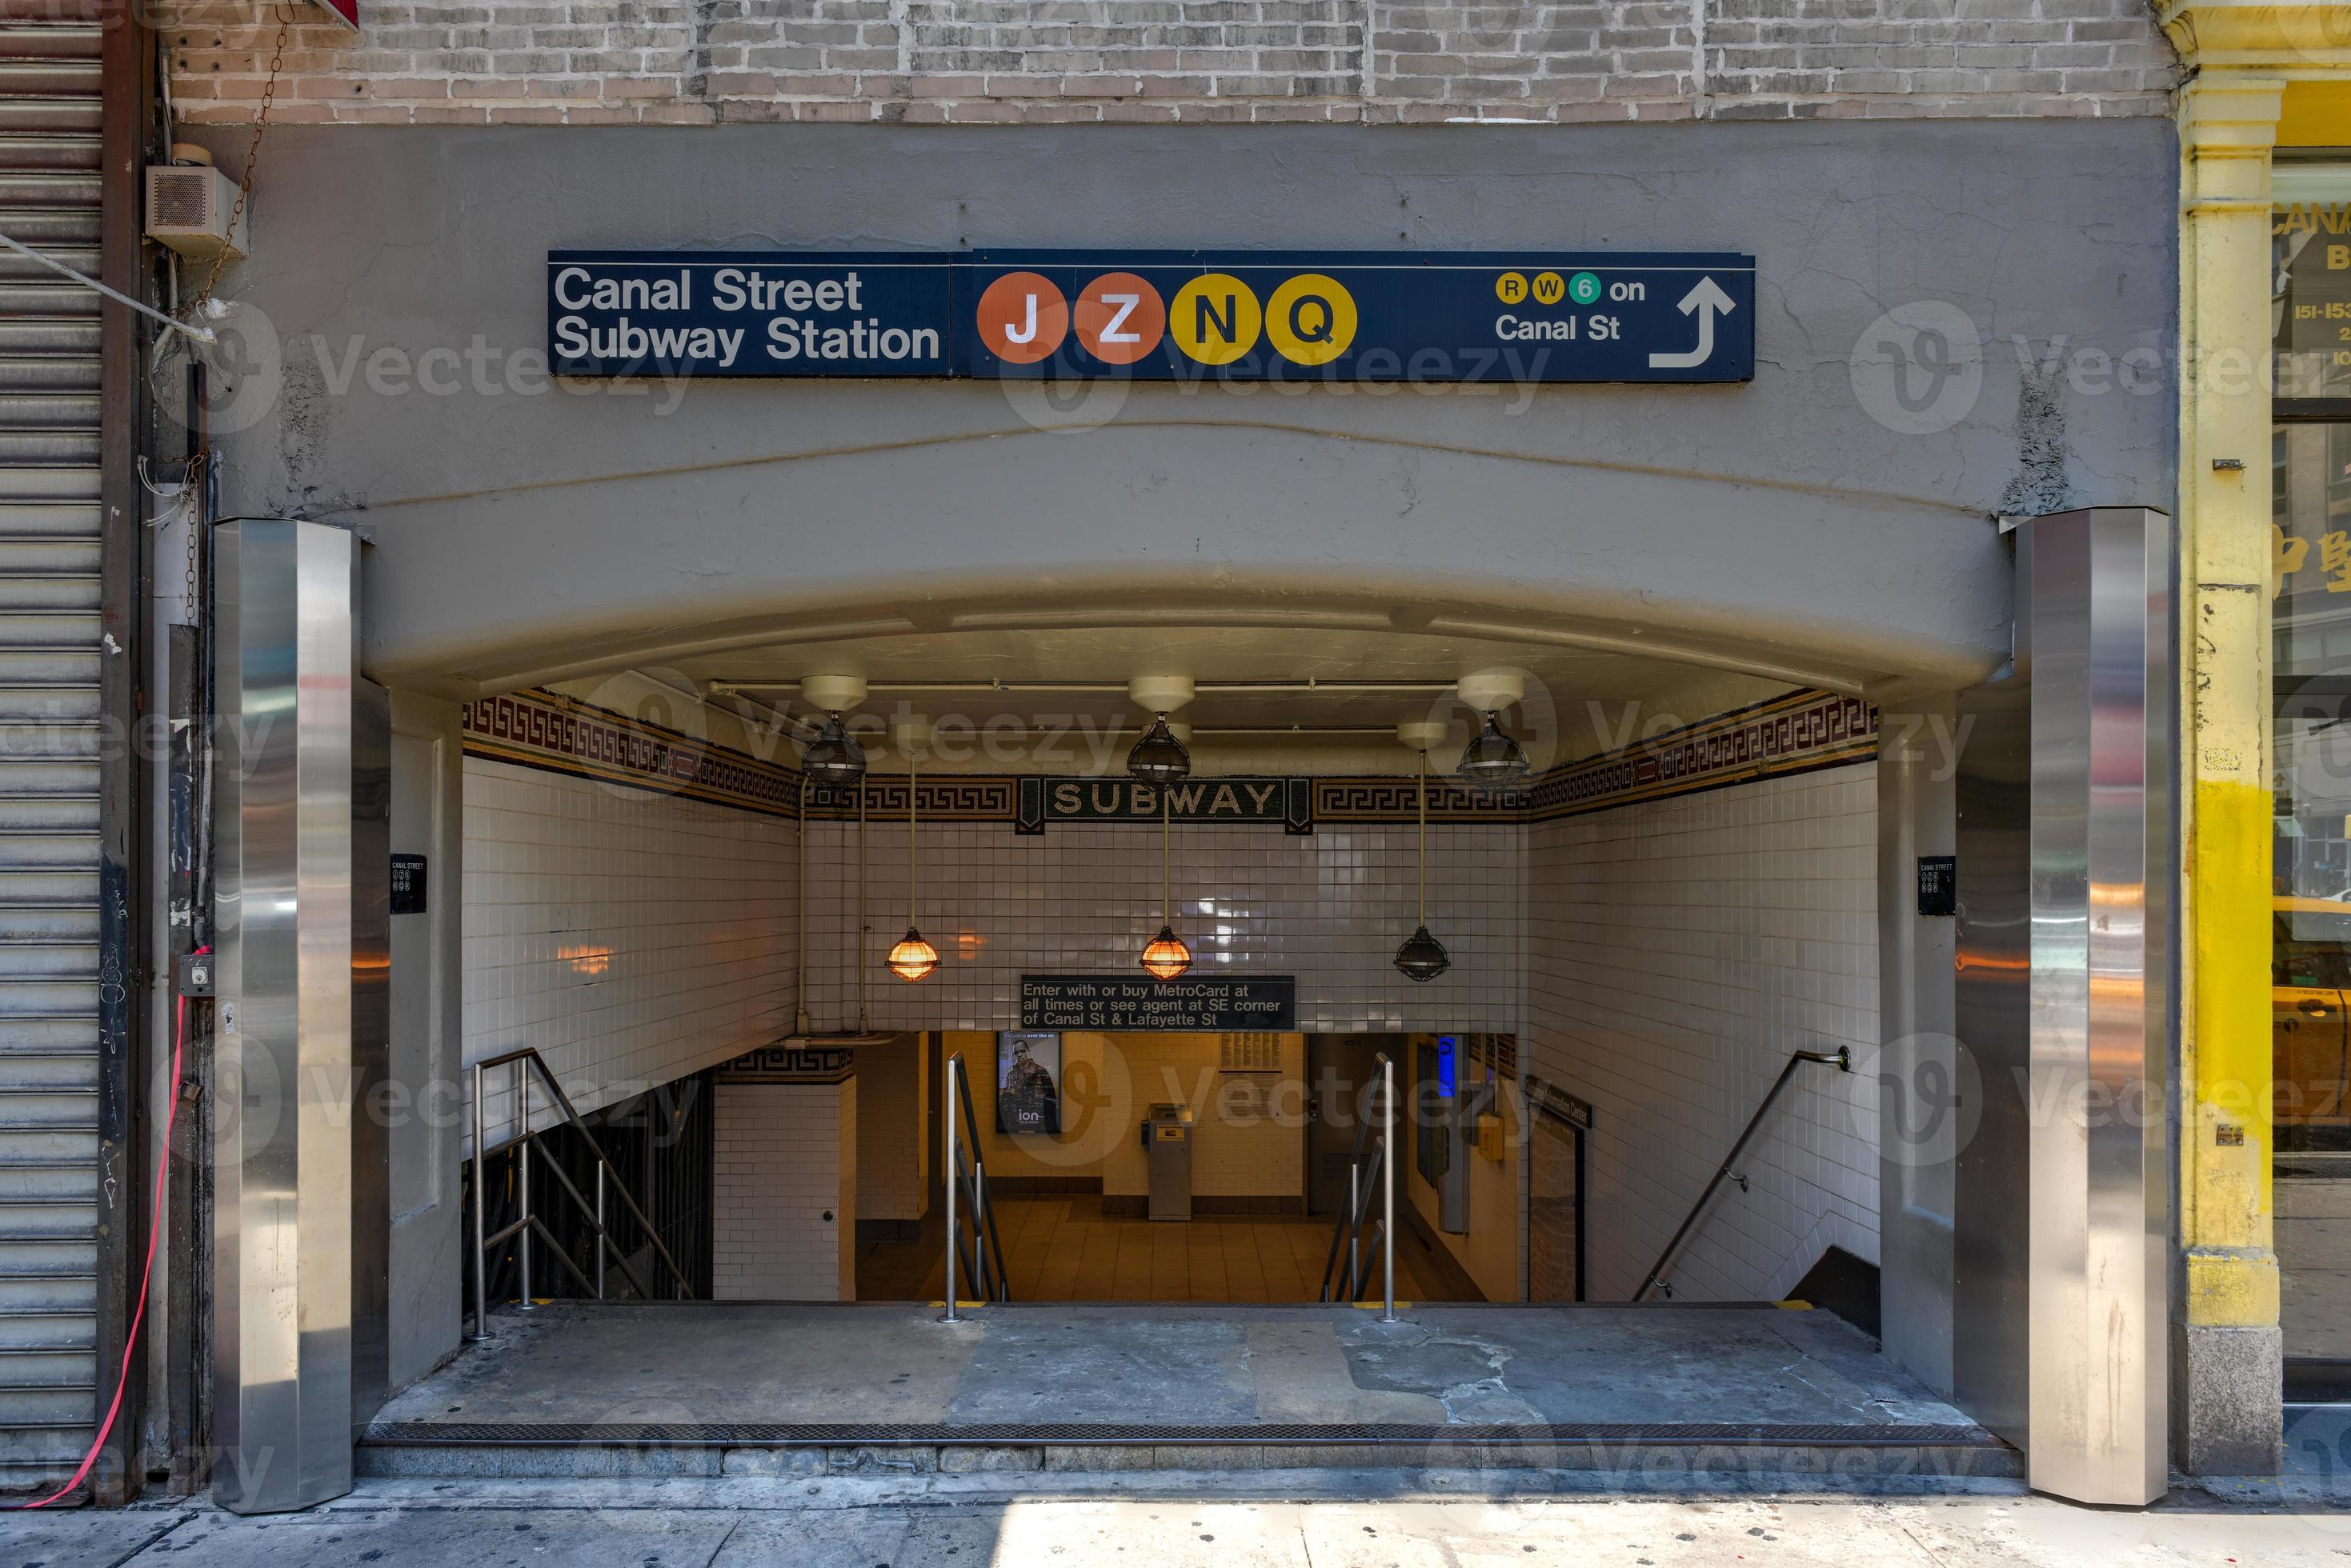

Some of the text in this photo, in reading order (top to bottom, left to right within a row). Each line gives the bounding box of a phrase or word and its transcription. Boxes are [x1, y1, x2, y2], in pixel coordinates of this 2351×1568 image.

[555, 268, 862, 311] Canal Street
[1504, 279, 1645, 302] R W 6 on
[1005, 294, 1334, 345] J Z N Q
[1495, 315, 1620, 341] Canal St
[555, 316, 939, 367] Subway Station
[1053, 783, 1277, 814] SUBWAY
[1023, 984, 1248, 998] Enter with or buy MetroCard at
[1023, 998, 1280, 1013] all times or see agent at SE corner
[1023, 1012, 1217, 1027] of Canal St & Lafayette St
[1019, 1109, 1039, 1120] ion
[1545, 1088, 1569, 1114] Information
[1570, 1102, 1588, 1123] Center
